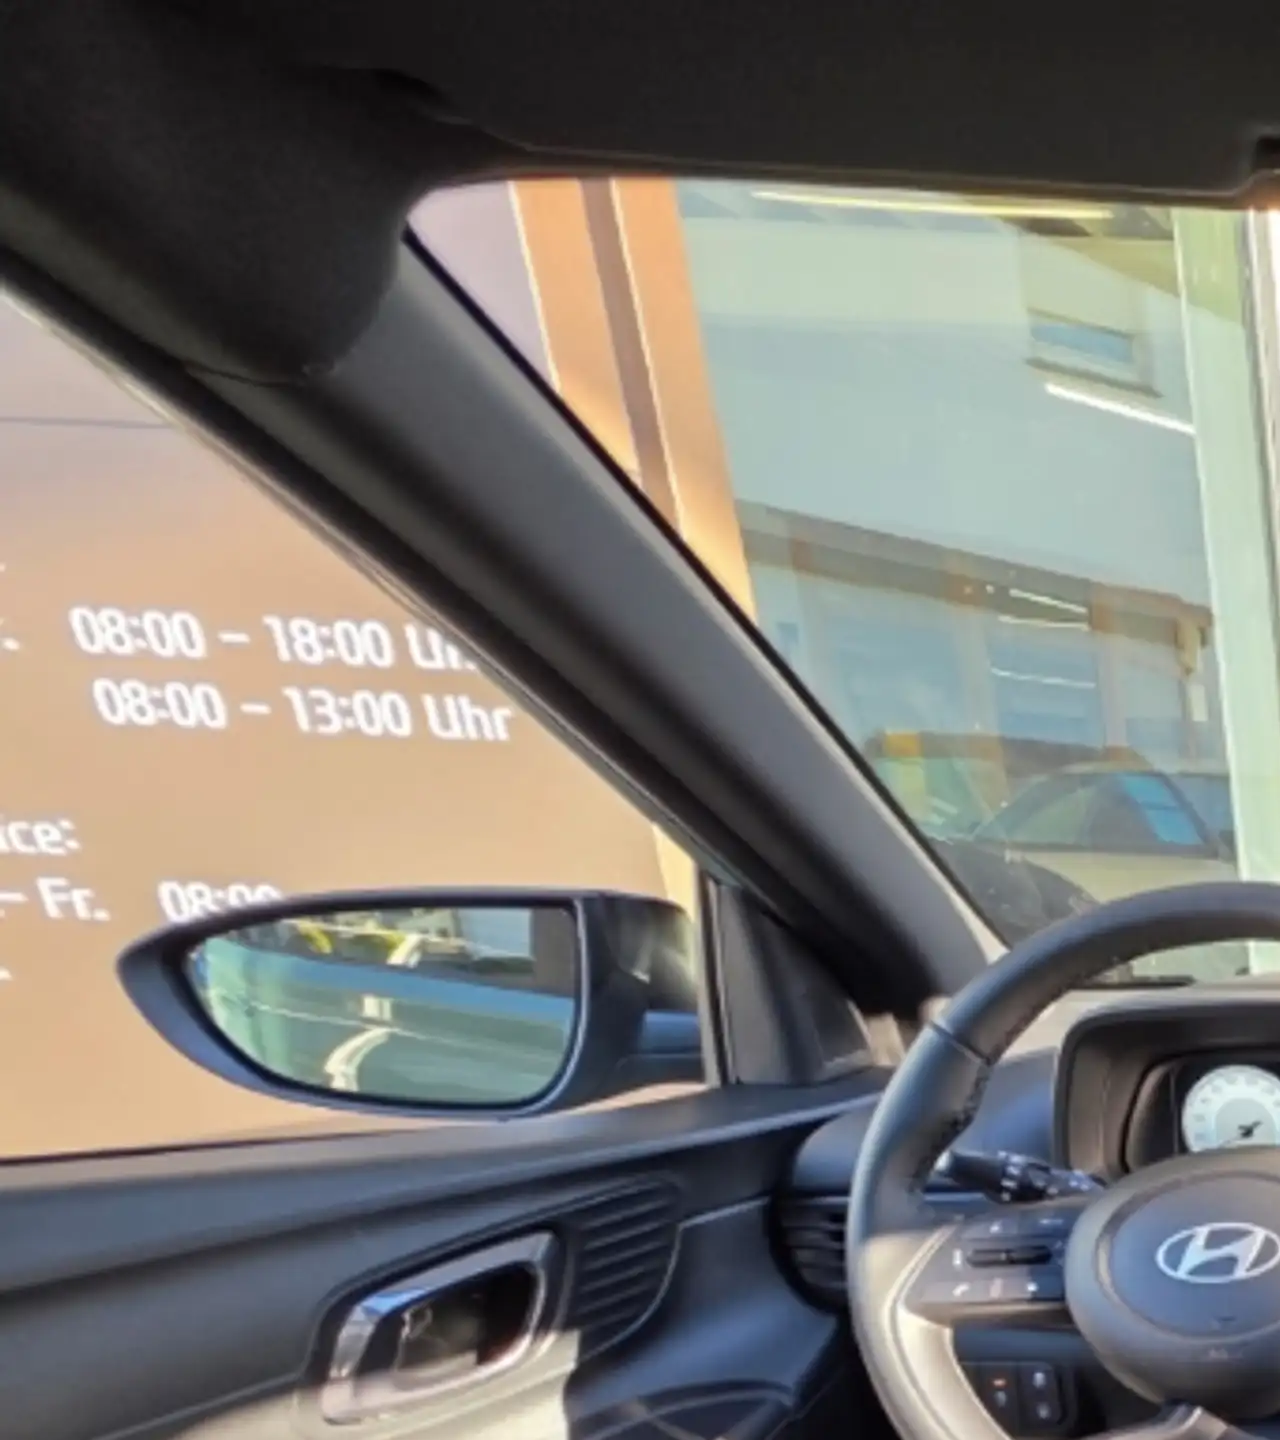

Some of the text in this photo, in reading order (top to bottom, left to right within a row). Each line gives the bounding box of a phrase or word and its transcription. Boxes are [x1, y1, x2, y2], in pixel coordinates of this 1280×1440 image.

[69, 606, 207, 659] 08:00
[262, 615, 394, 667] 18:00
[93, 677, 228, 729] 08:00
[282, 686, 412, 737] 13:00
[421, 693, 512, 740] Uhr
[36, 876, 111, 921] Fr.
